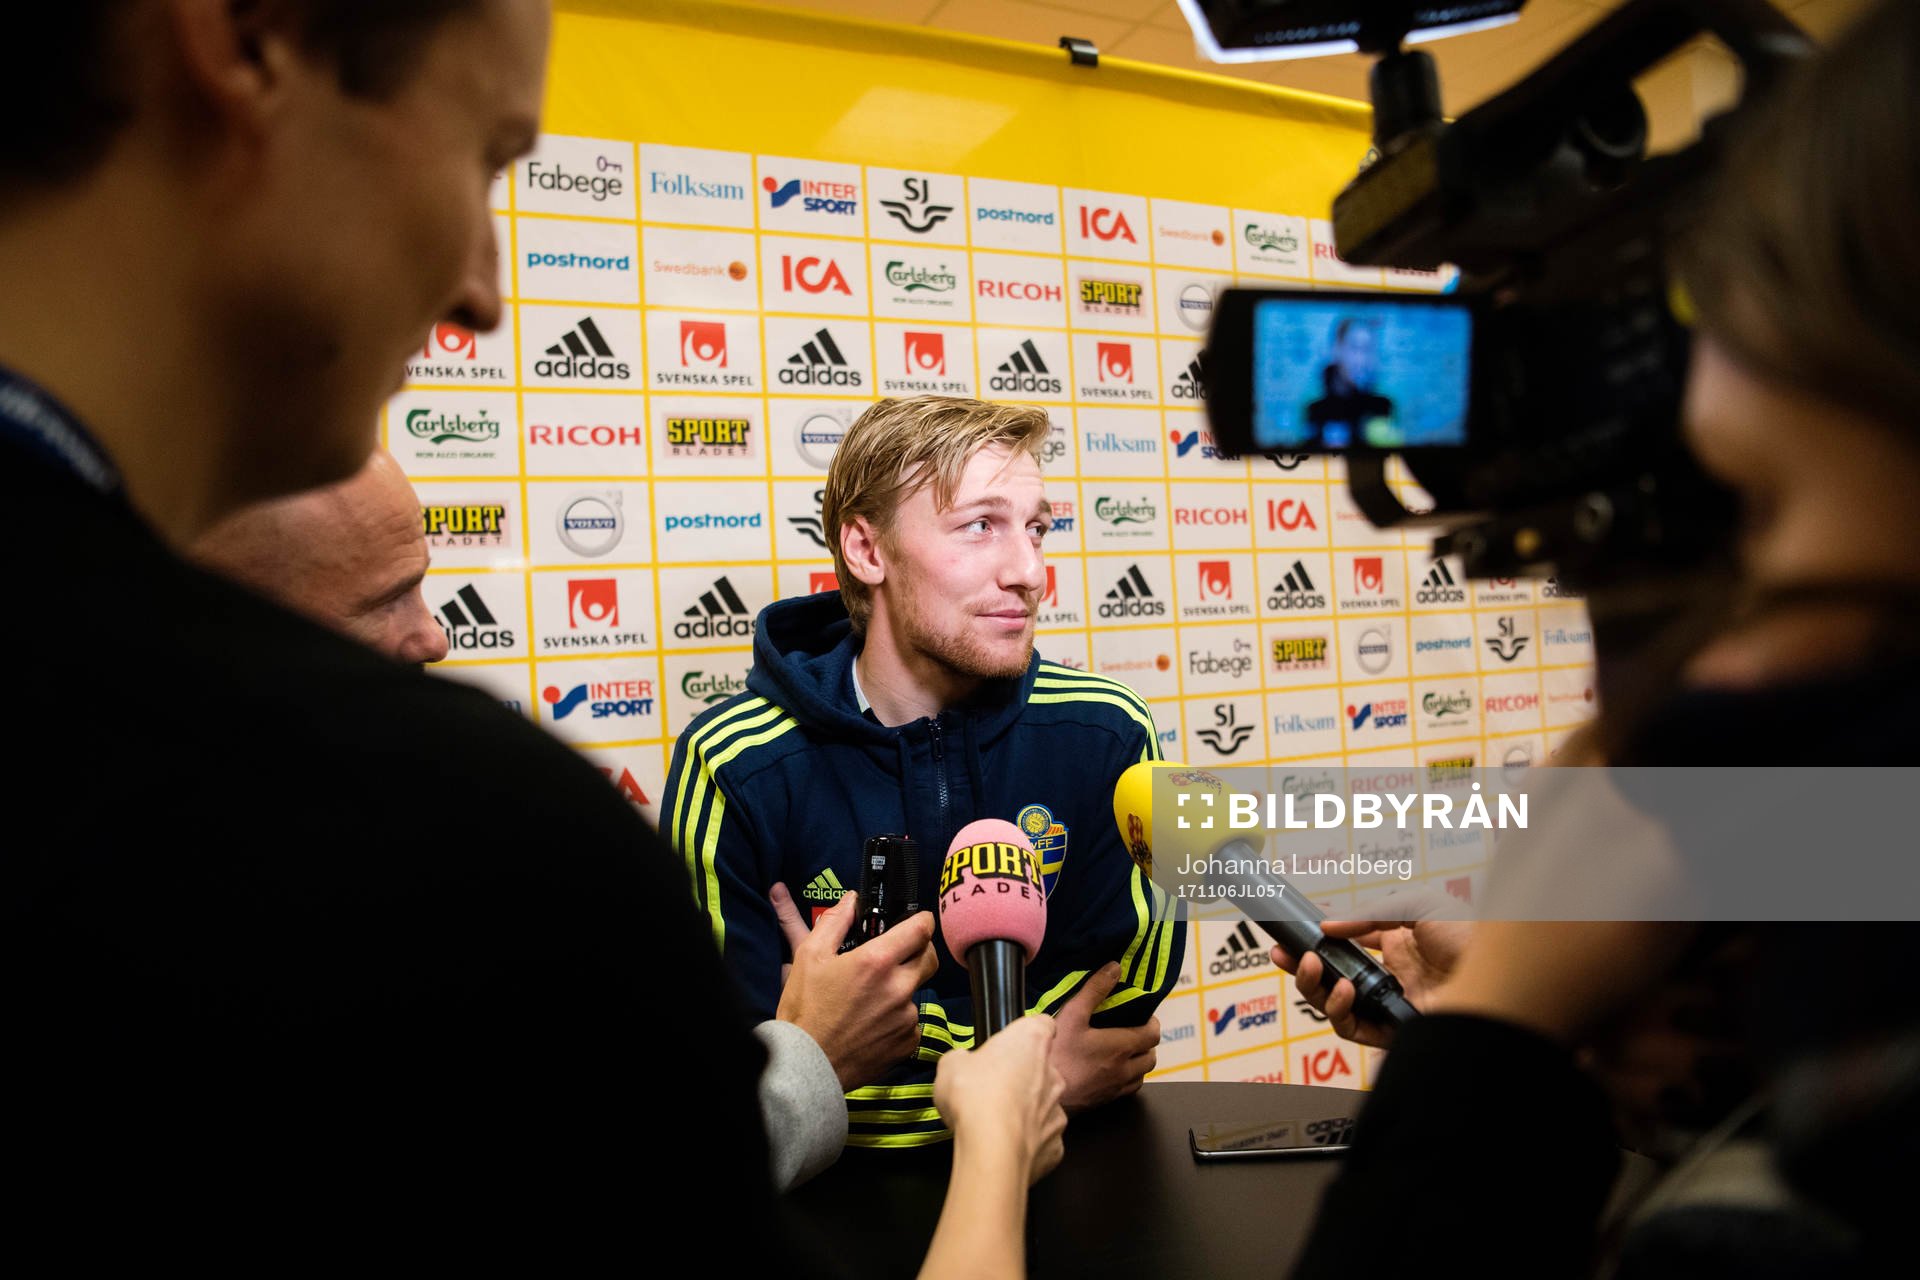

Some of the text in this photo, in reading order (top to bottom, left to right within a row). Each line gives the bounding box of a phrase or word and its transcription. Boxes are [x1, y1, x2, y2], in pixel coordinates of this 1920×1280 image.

[528, 162, 623, 201] Fabege
[651, 171, 744, 200] Folksam
[803, 180, 857, 200] INTER
[903, 177, 929, 204] SJ
[804, 198, 857, 216] SPORT
[977, 207, 1054, 225] postnord
[1080, 205, 1137, 244] ICA
[527, 251, 630, 271] postnord
[653, 260, 725, 277] Swedbank
[782, 255, 853, 296] ICA
[885, 261, 956, 292] Carlsberg
[978, 279, 1061, 302] RICOH
[1080, 280, 1142, 308] SPORT
[1084, 304, 1142, 316] BLADET
[405, 365, 507, 379] VENSKA SPEL
[534, 353, 631, 380] adidas
[778, 365, 862, 386] adidas
[657, 373, 754, 387] SVENSKA SPEL
[885, 380, 968, 393] SVENSKA SPEL
[990, 374, 1061, 393] adidas
[1081, 386, 1153, 400] SVENSKA SPEL
[1171, 382, 1207, 400] adi
[406, 409, 500, 444] Carlsberg
[529, 425, 641, 446] RICOH
[666, 418, 750, 446] SPORT
[672, 447, 749, 456] BLADET
[1086, 432, 1156, 453] Folksam
[1050, 502, 1073, 516] TER
[1095, 496, 1156, 526] Carlsberg
[1174, 508, 1248, 526] RICOH
[1267, 499, 1317, 531] ICA
[566, 518, 615, 530] VOLVO
[665, 512, 761, 532] postnord
[1050, 518, 1074, 532] ORT
[432, 535, 502, 546] LADET
[1267, 592, 1325, 611] adidas
[1416, 589, 1465, 604] adidas
[1055, 613, 1079, 623] SPEL
[1099, 600, 1165, 618] adidas
[1183, 604, 1250, 617] SVENSKA SPEL
[1498, 617, 1514, 637] SJ
[446, 626, 515, 650] idas
[543, 633, 648, 649] SVENSKA SPEL
[1416, 637, 1472, 652] postnord
[1272, 638, 1327, 662] SPORT
[1189, 651, 1251, 678] Fabege
[591, 680, 652, 699] INTER
[681, 671, 746, 703] Carlsbe
[591, 699, 654, 718] SPORT
[1371, 700, 1407, 714] INTER
[1485, 694, 1539, 712] RICOH
[1214, 704, 1235, 727] SJ
[1274, 715, 1335, 735] Folksam
[1374, 714, 1408, 729] SPORT
[1352, 773, 1414, 793] RICOH
[940, 842, 1043, 899] SPORT
[941, 881, 1044, 913] BLADET
[1209, 951, 1271, 976] adidas
[1236, 995, 1277, 1016] INTER
[1238, 1010, 1278, 1031] SPORT
[1302, 1048, 1352, 1085] ICA
